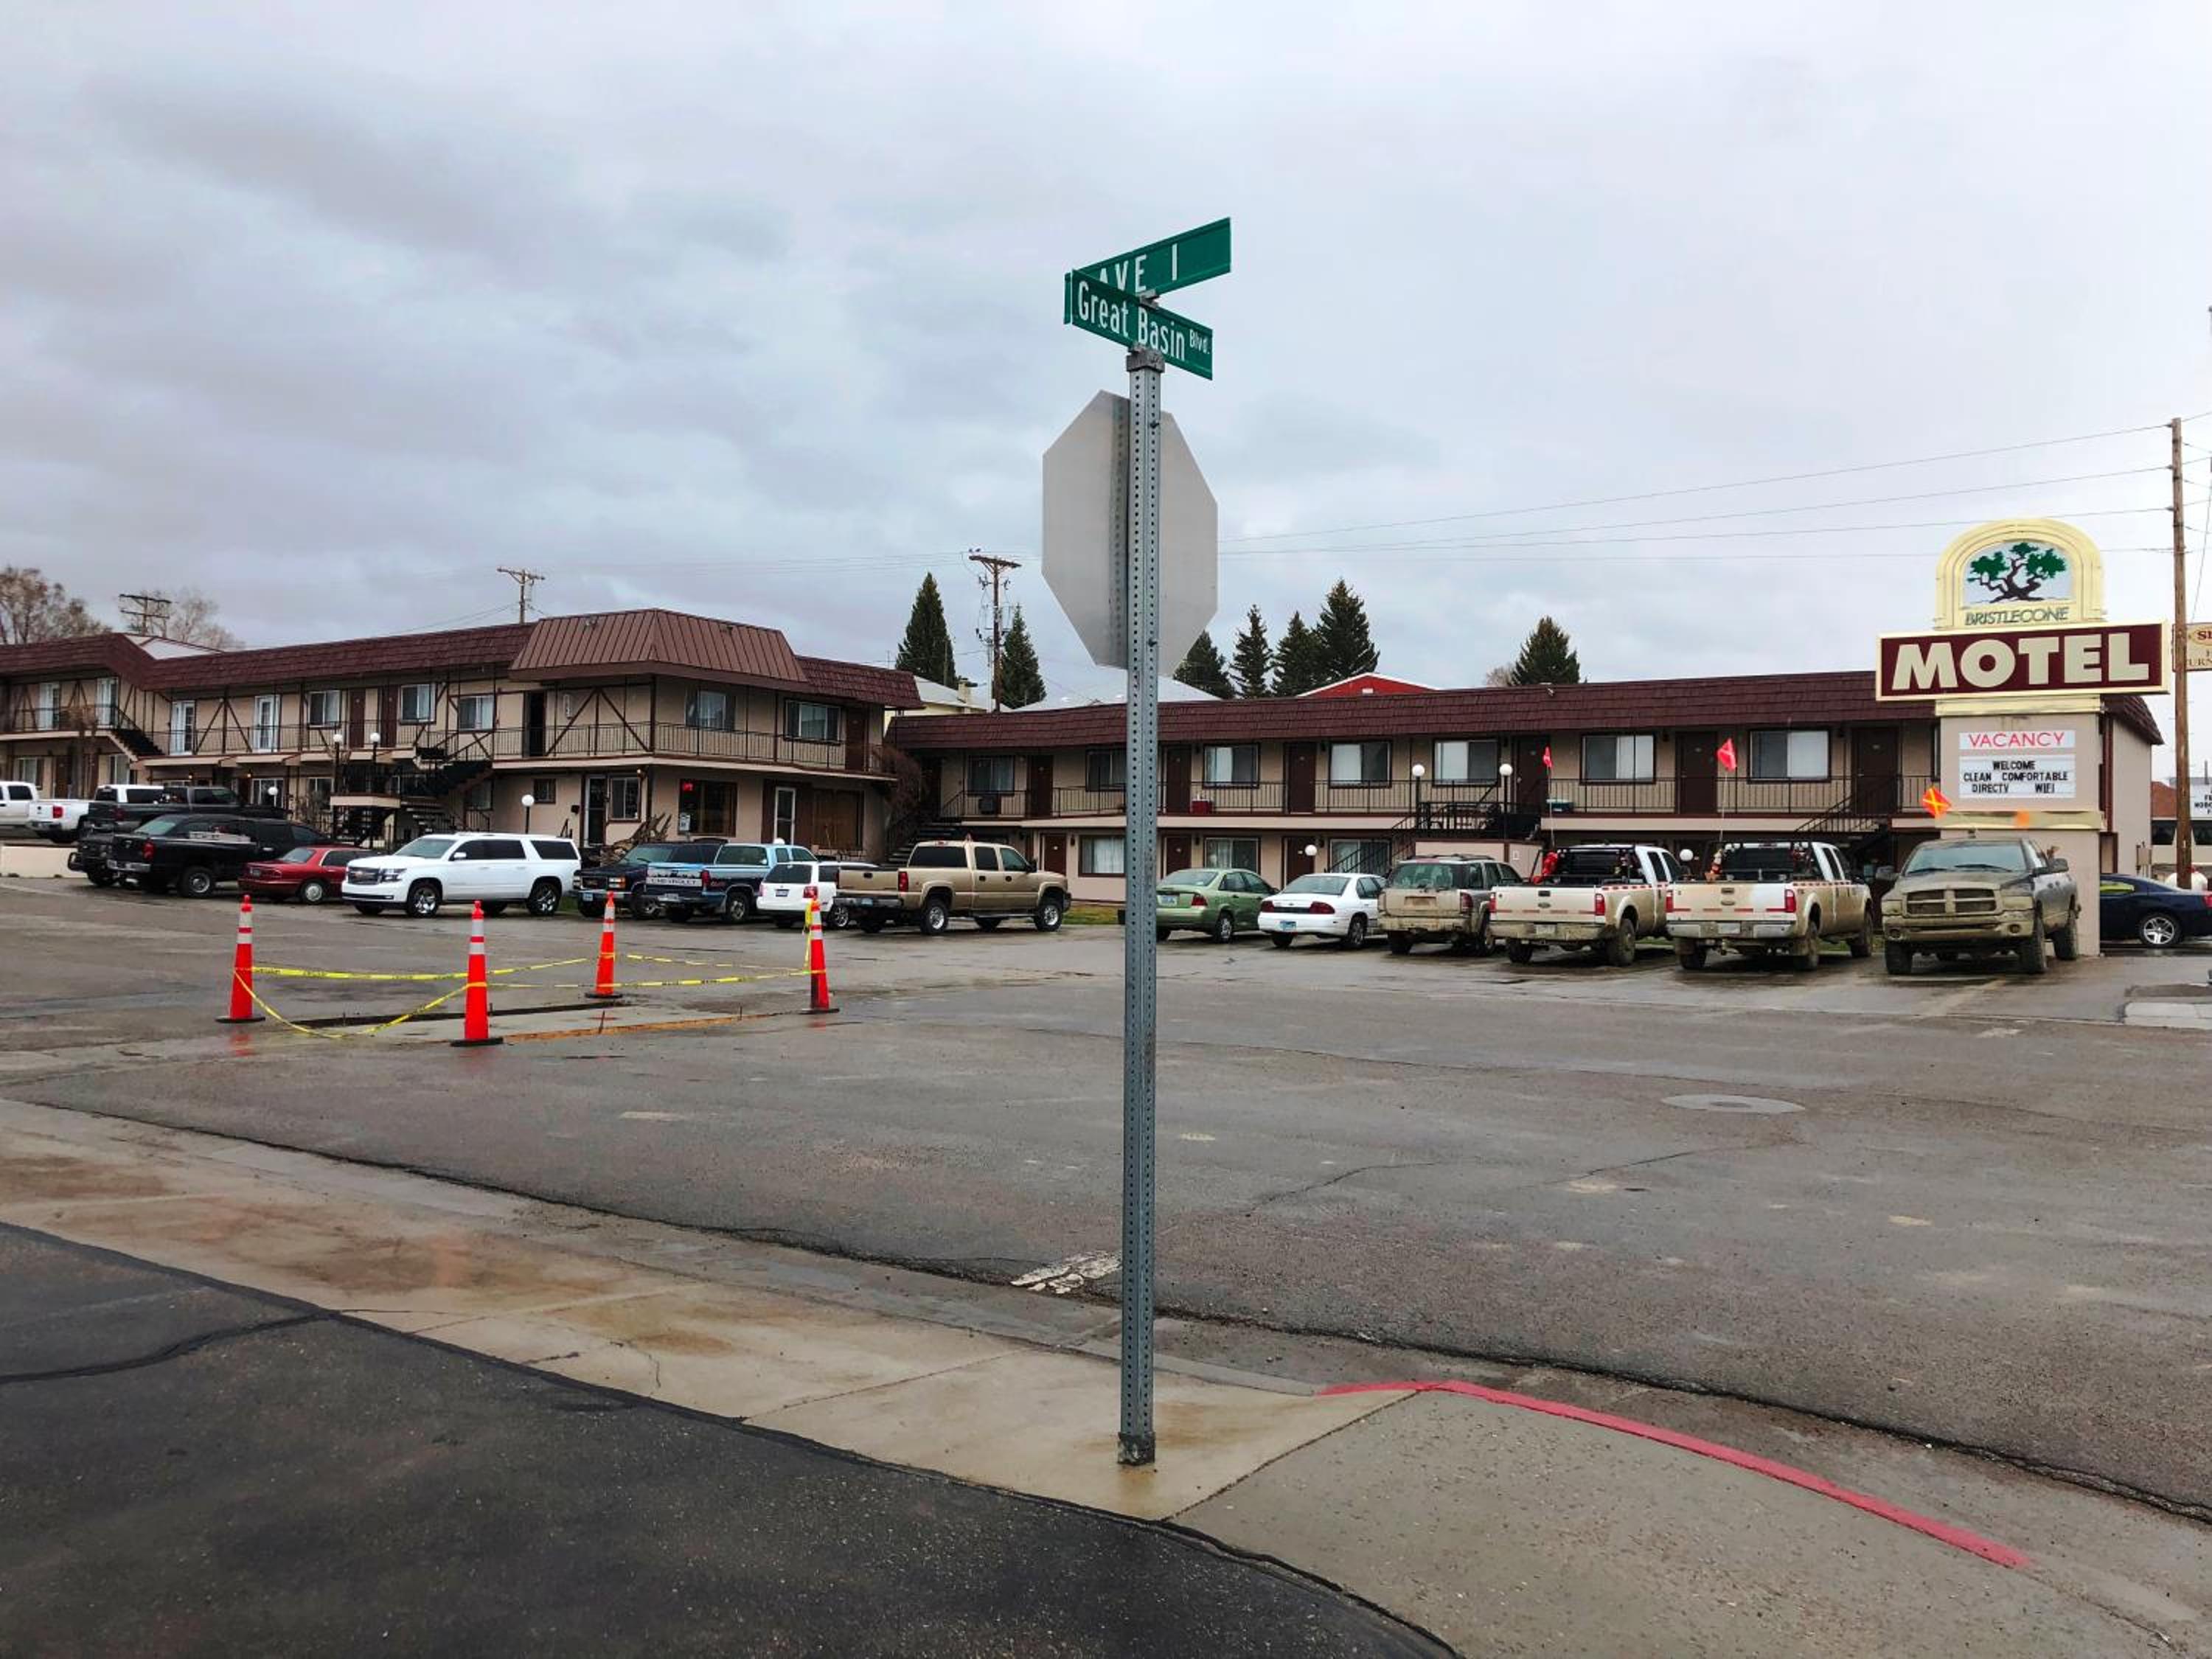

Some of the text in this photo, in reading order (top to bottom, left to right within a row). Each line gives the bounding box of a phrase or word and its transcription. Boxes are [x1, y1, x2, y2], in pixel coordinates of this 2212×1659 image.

[1172, 243, 1178, 281] I
[1078, 281, 1129, 337] Great
[1138, 305, 1186, 361] Basin
[1964, 607, 2070, 626] BRISTLECONE
[1892, 633, 2149, 691] MOTEL
[1969, 732, 2065, 748] VACANCY
[1992, 760, 2036, 771] WELCOME
[1964, 771, 2068, 782] CLEAN COMFORTABLE
[1972, 783, 2055, 793] DIRECTV WIFI
